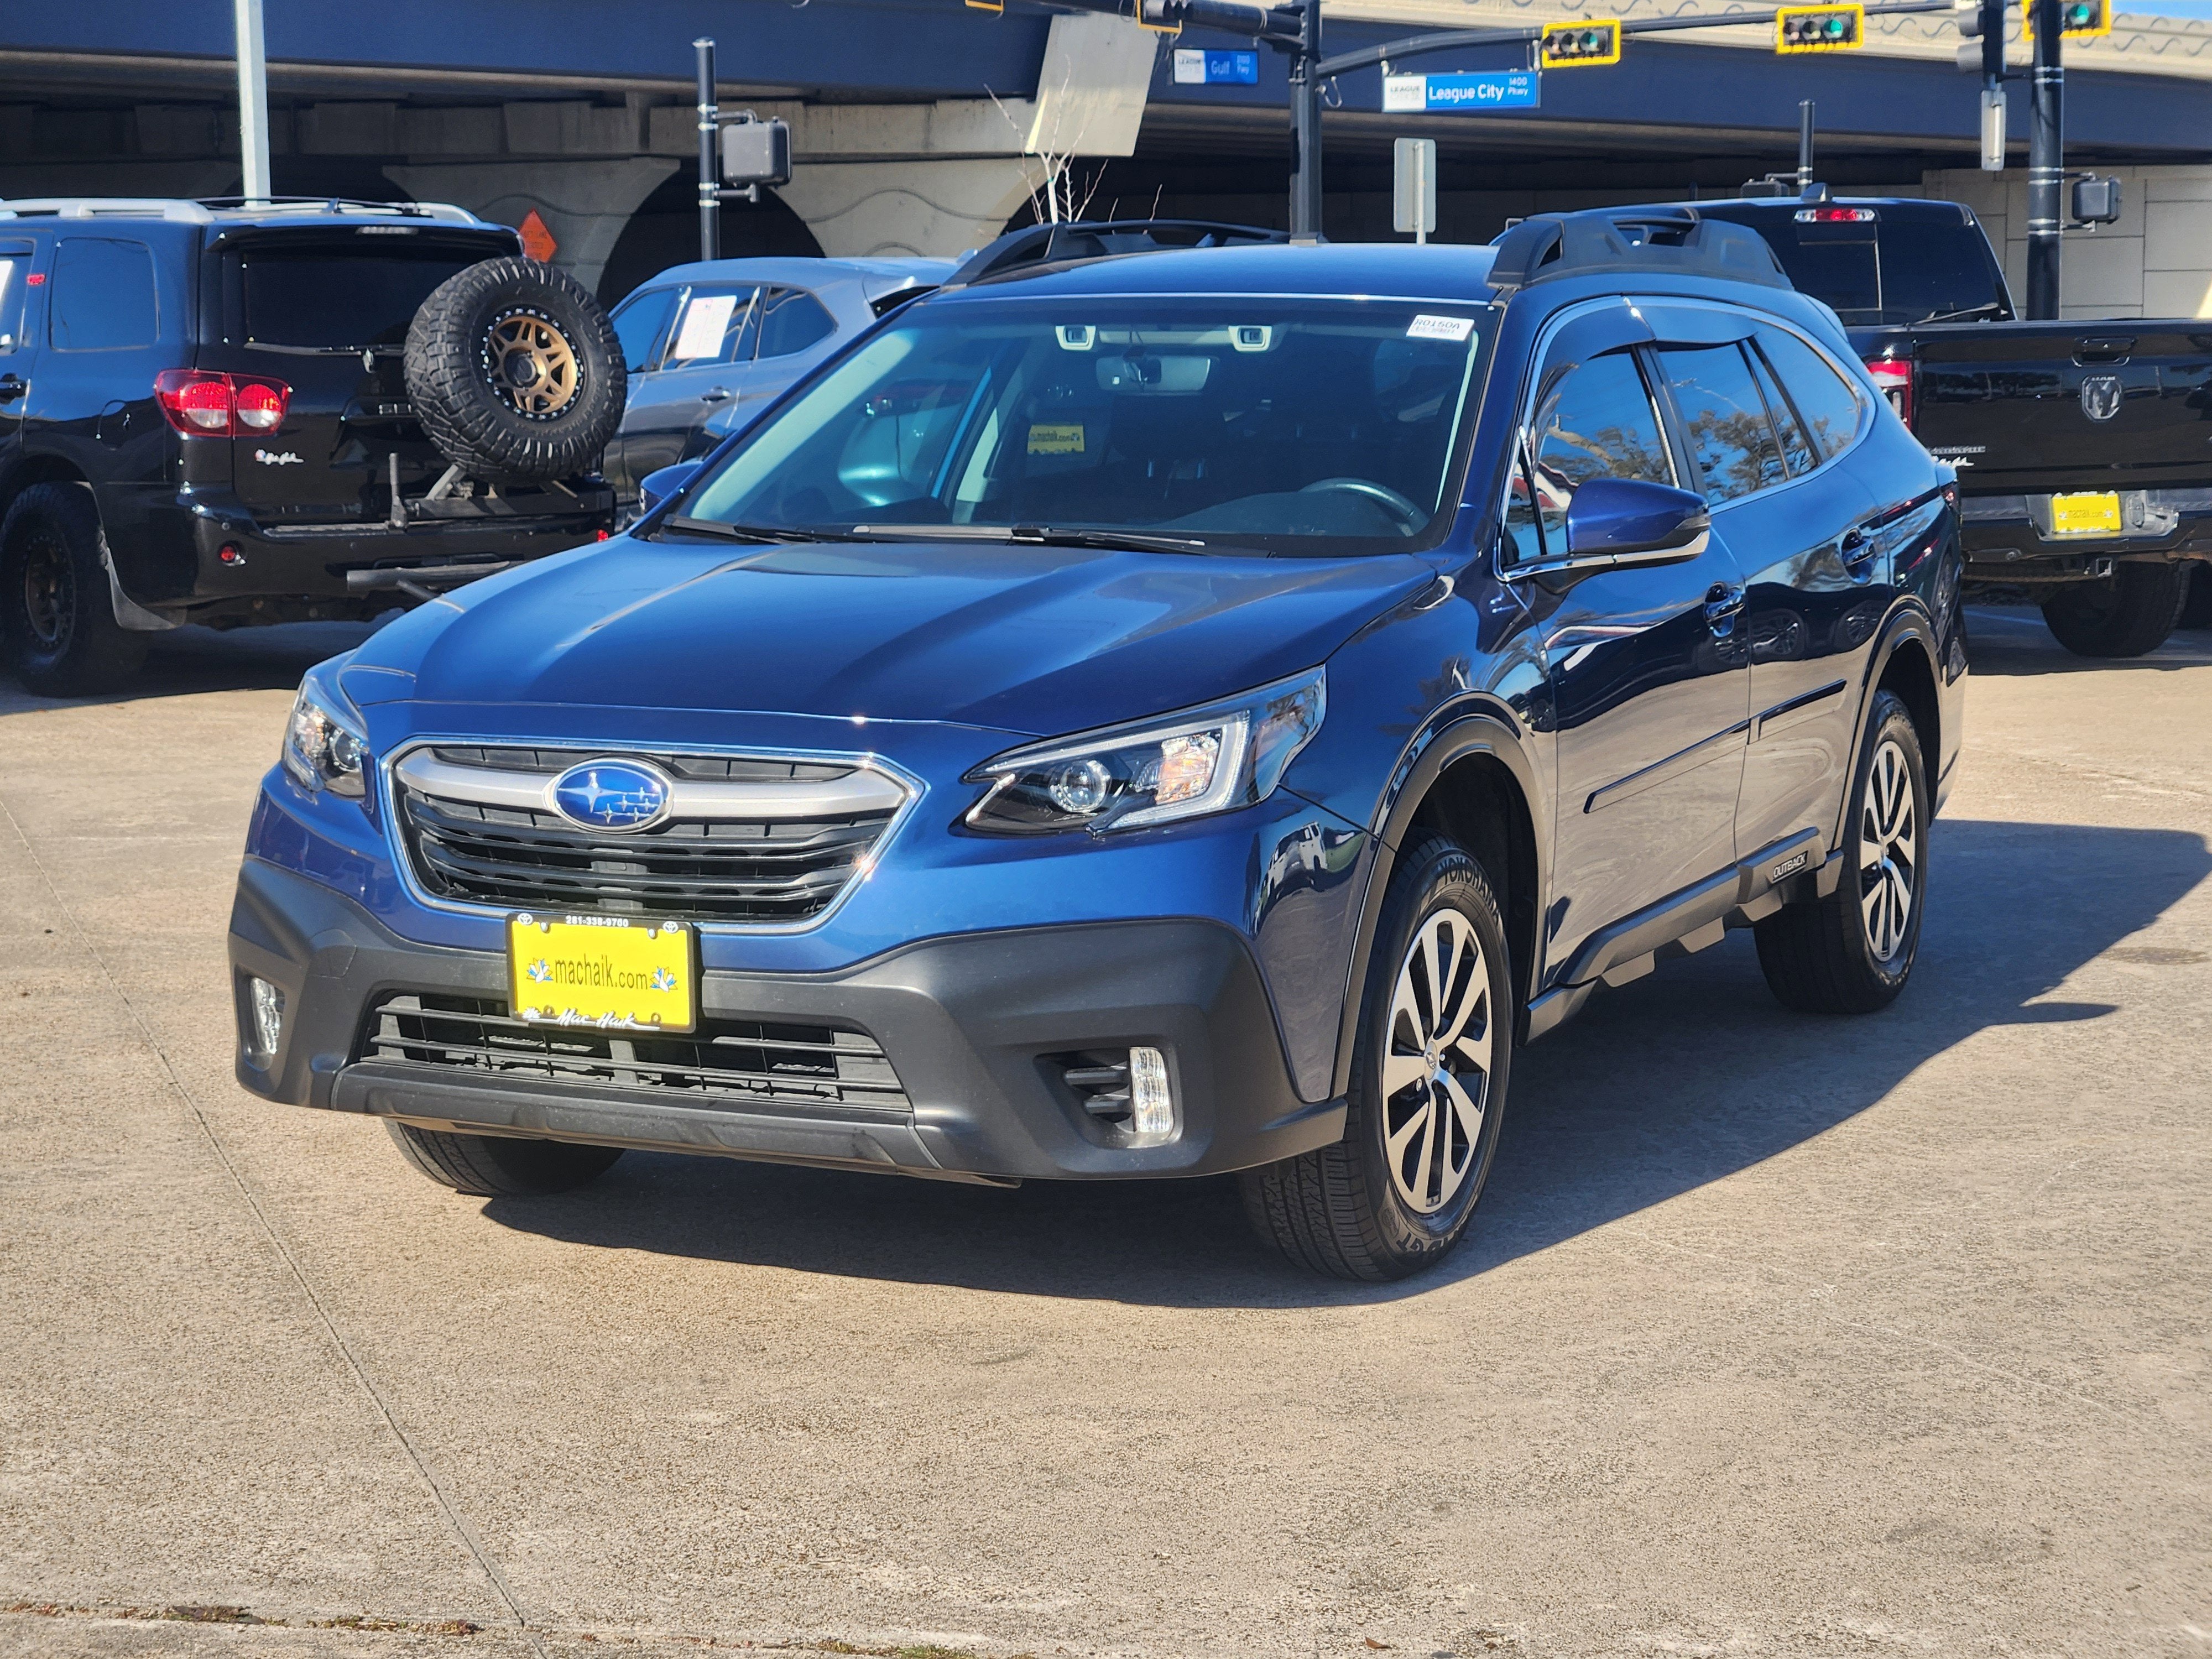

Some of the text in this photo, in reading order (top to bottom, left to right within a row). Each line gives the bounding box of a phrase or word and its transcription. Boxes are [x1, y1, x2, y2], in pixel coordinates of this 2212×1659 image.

[1507, 86, 1528, 96] Pkwy
[1509, 76, 1528, 86] 1400
[1428, 85, 1476, 104] League
[1477, 84, 1504, 101] City
[1773, 852, 1807, 878] OUTBACK
[555, 953, 648, 990] machaik.com
[557, 1008, 636, 1029] Mac Haik
